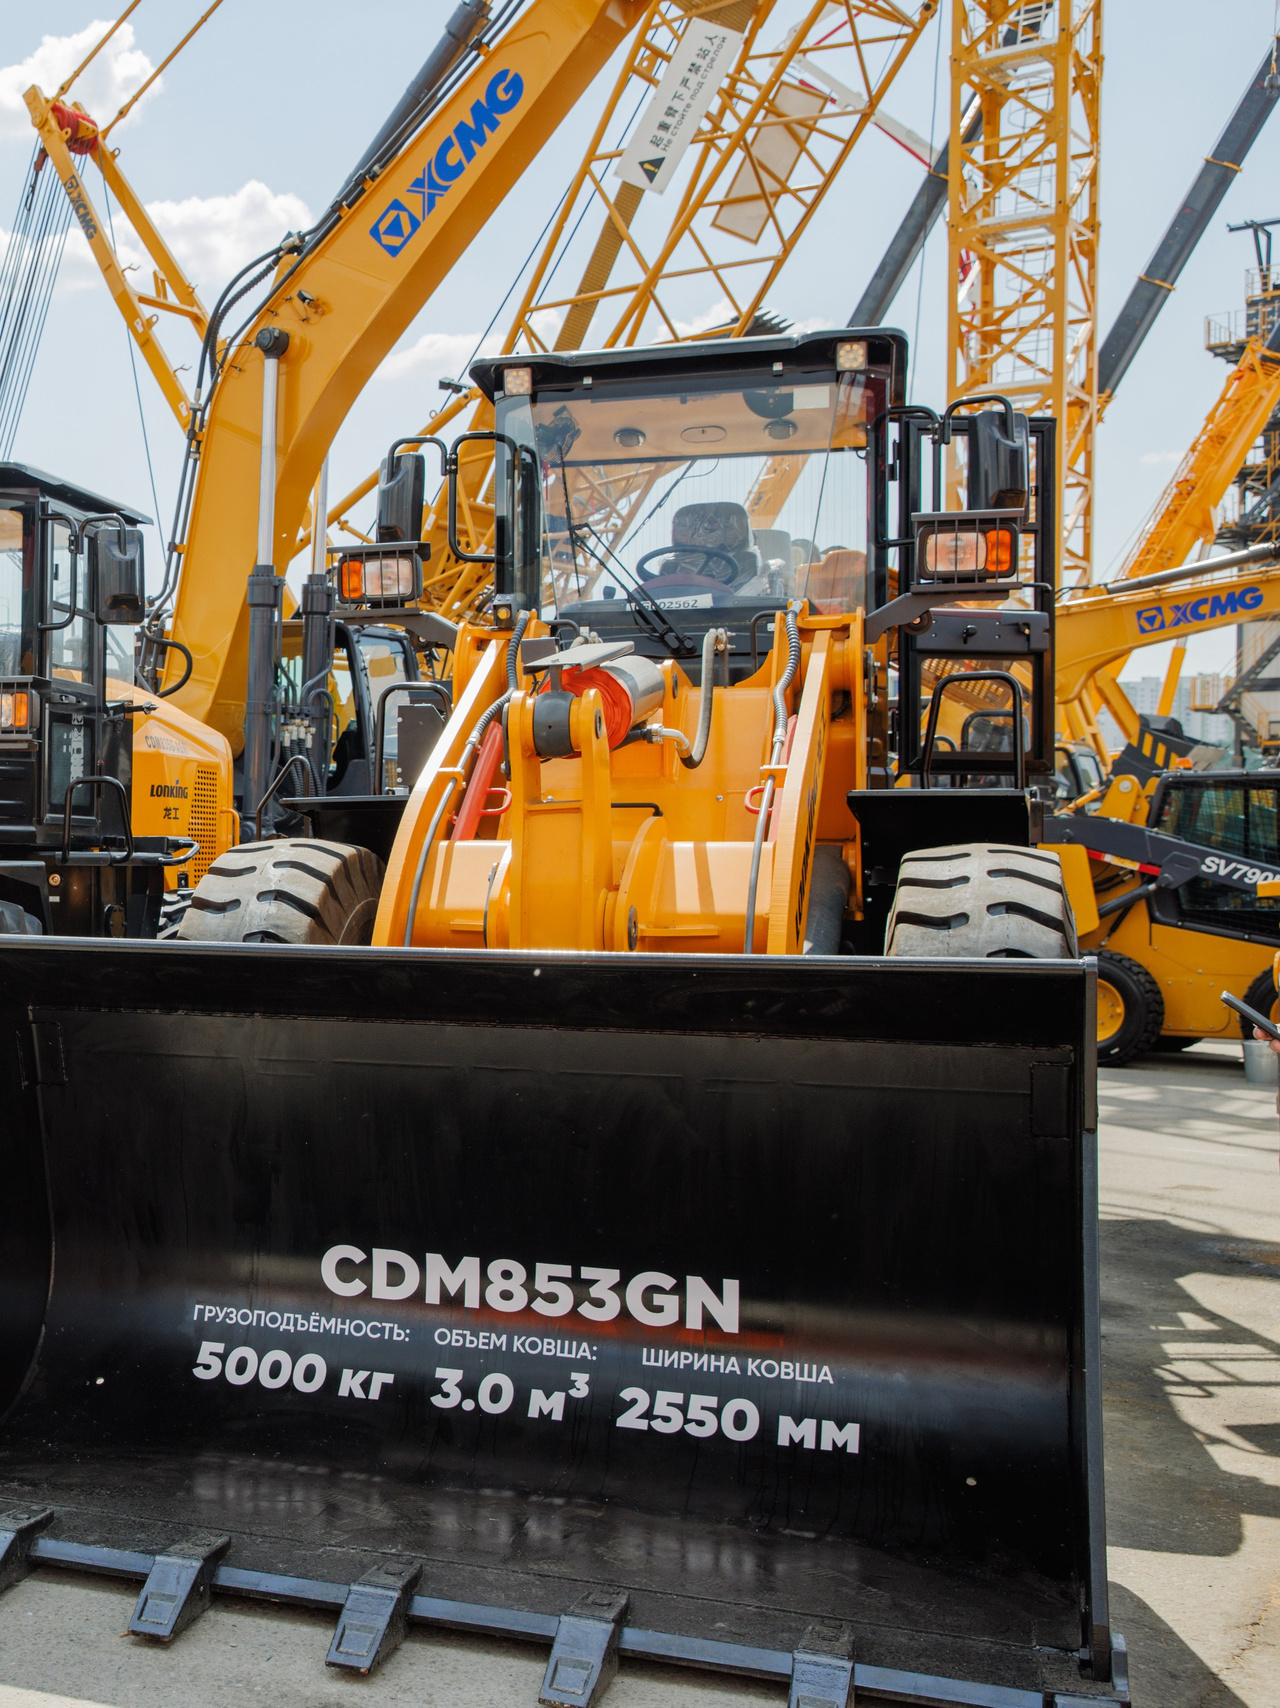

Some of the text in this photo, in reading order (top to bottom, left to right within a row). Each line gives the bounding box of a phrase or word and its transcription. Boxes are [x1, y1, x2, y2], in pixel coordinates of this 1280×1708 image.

[671, 104, 692, 136] стойте
[691, 81, 705, 101] под
[702, 36, 727, 79] стрелой
[405, 68, 524, 223] XCMG
[69, 191, 97, 240] XCMG
[1167, 586, 1264, 628] XCMG
[163, 806, 179, 820] 龙工
[1200, 856, 1280, 884] SV790
[321, 1244, 739, 1334] CDM853GN
[193, 1304, 834, 1384] ГРУЗОПОДЪЁМНОСТЬ: ОБЪЕМ КОВША: ШИРИНА КОВША
[192, 1341, 327, 1393] 5000
[338, 1368, 394, 1400] кг
[430, 1367, 514, 1414] 3.0
[615, 1386, 760, 1442] 2550
[777, 1415, 860, 1454] мм
